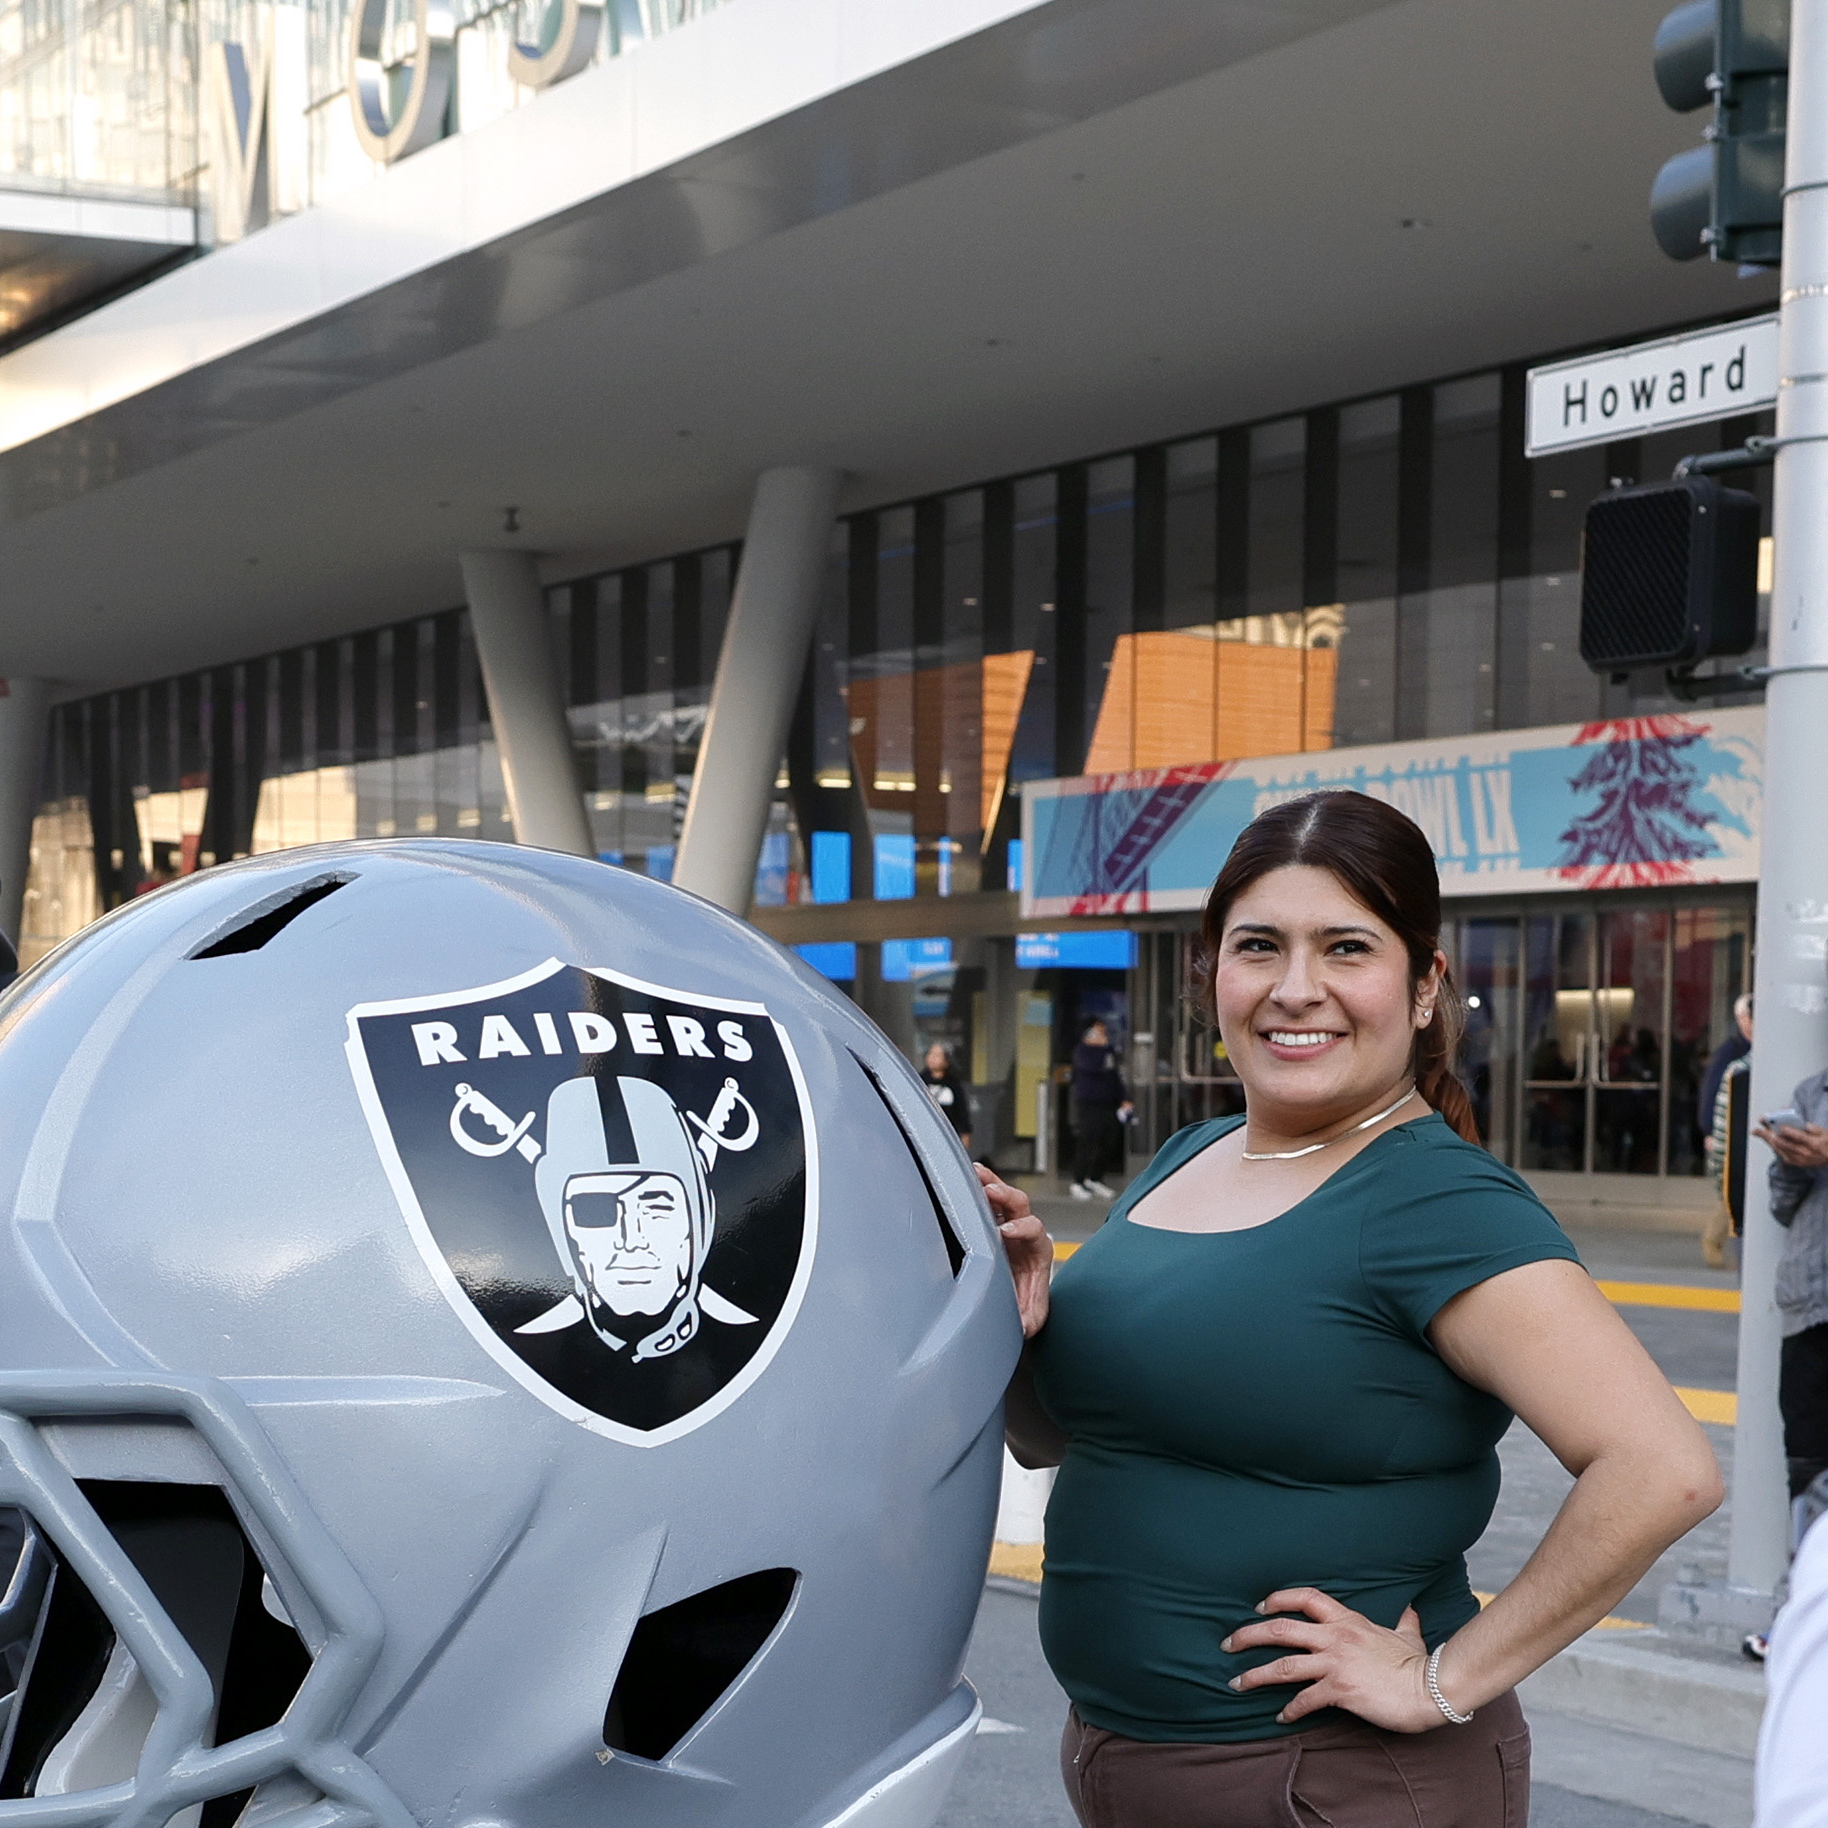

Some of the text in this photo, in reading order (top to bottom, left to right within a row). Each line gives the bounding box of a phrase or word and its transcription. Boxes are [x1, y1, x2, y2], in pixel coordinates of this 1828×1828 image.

[1562, 345, 1749, 427] Howard
[1469, 770, 1521, 857] LX
[411, 1012, 754, 1066] RAIDERS
